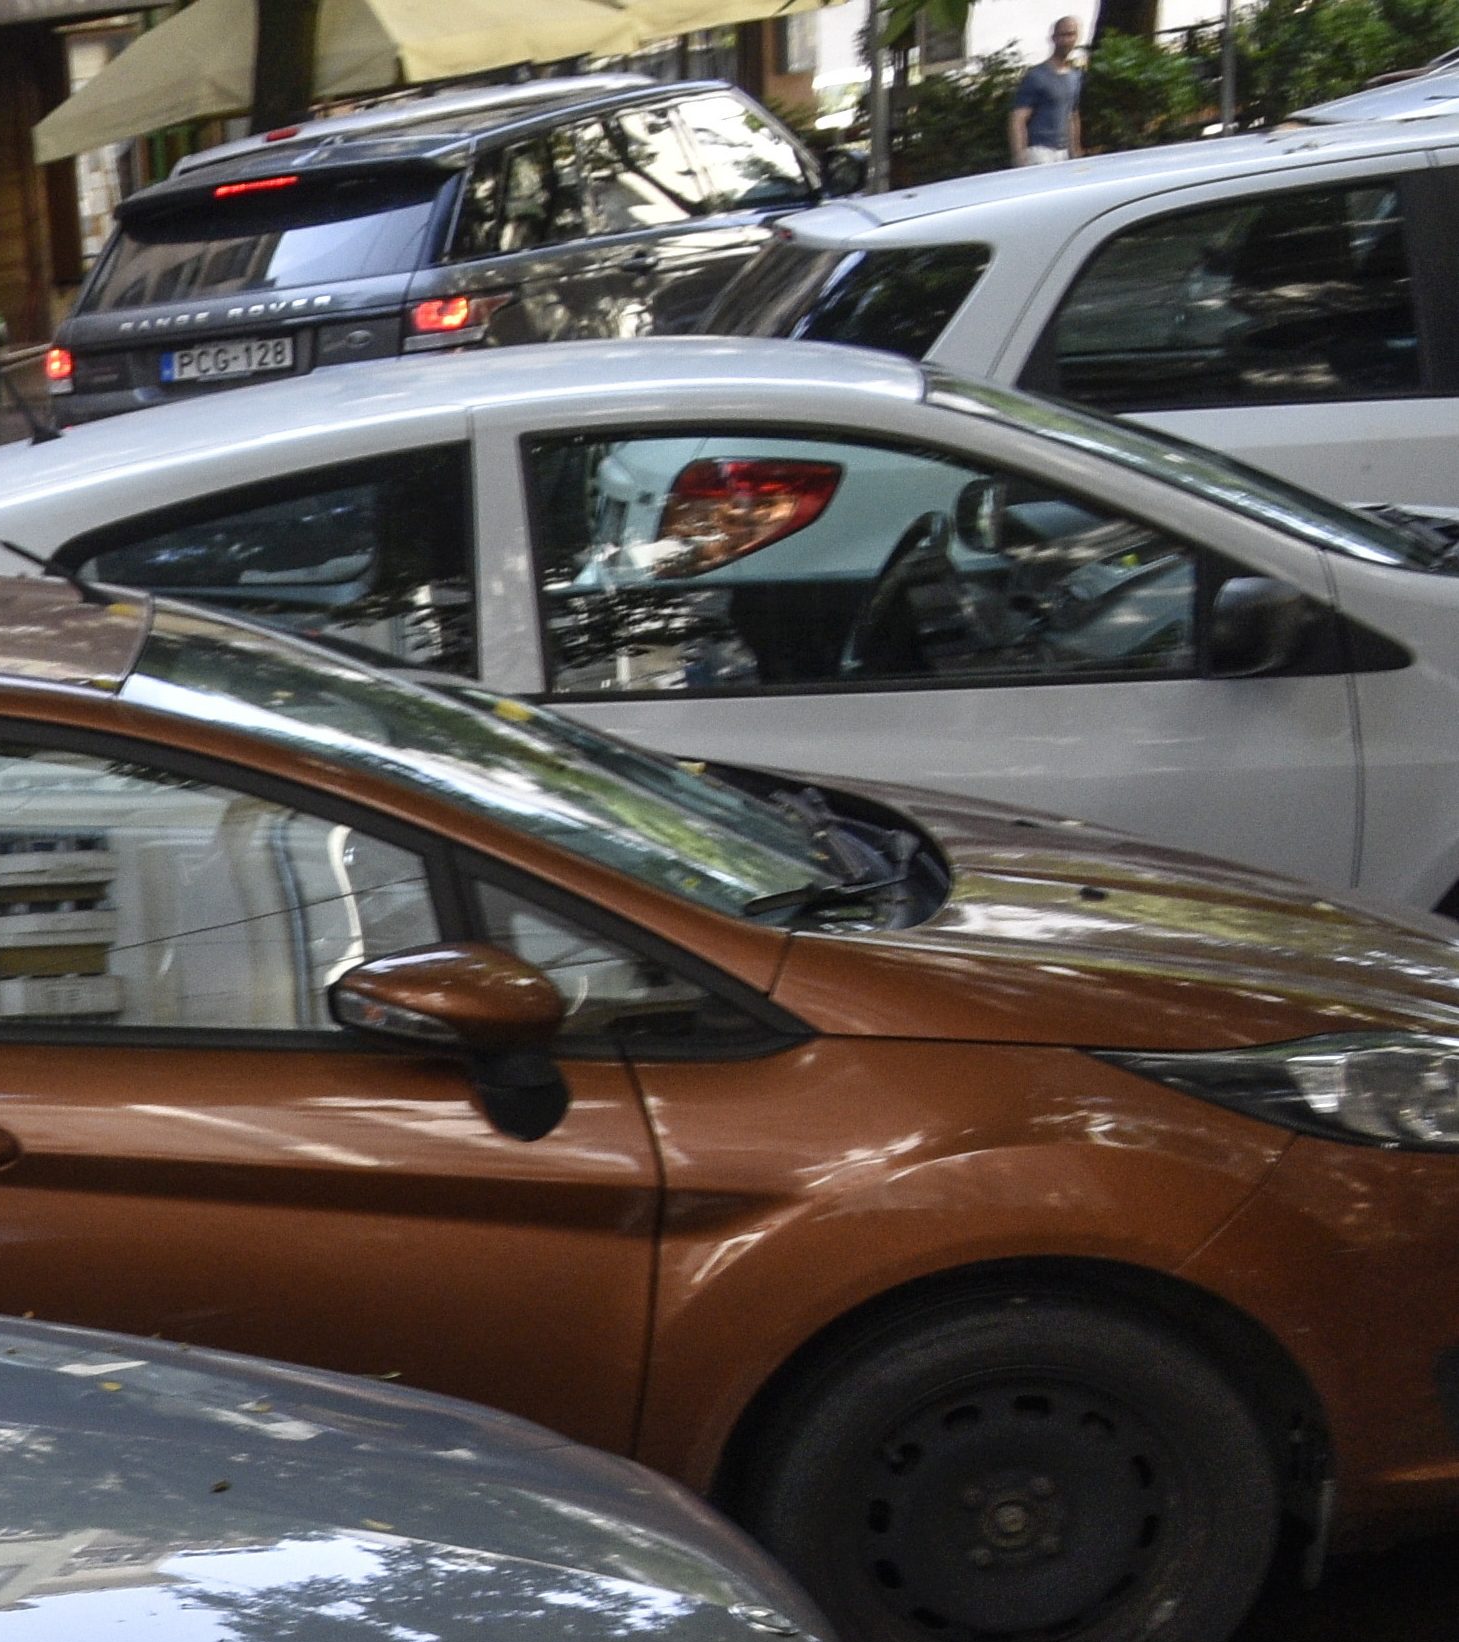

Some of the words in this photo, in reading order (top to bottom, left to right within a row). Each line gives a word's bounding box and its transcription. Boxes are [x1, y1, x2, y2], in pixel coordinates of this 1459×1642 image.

[119, 311, 210, 332] RANGE
[227, 295, 332, 319] ROVER
[177, 341, 287, 377] PCG-128
